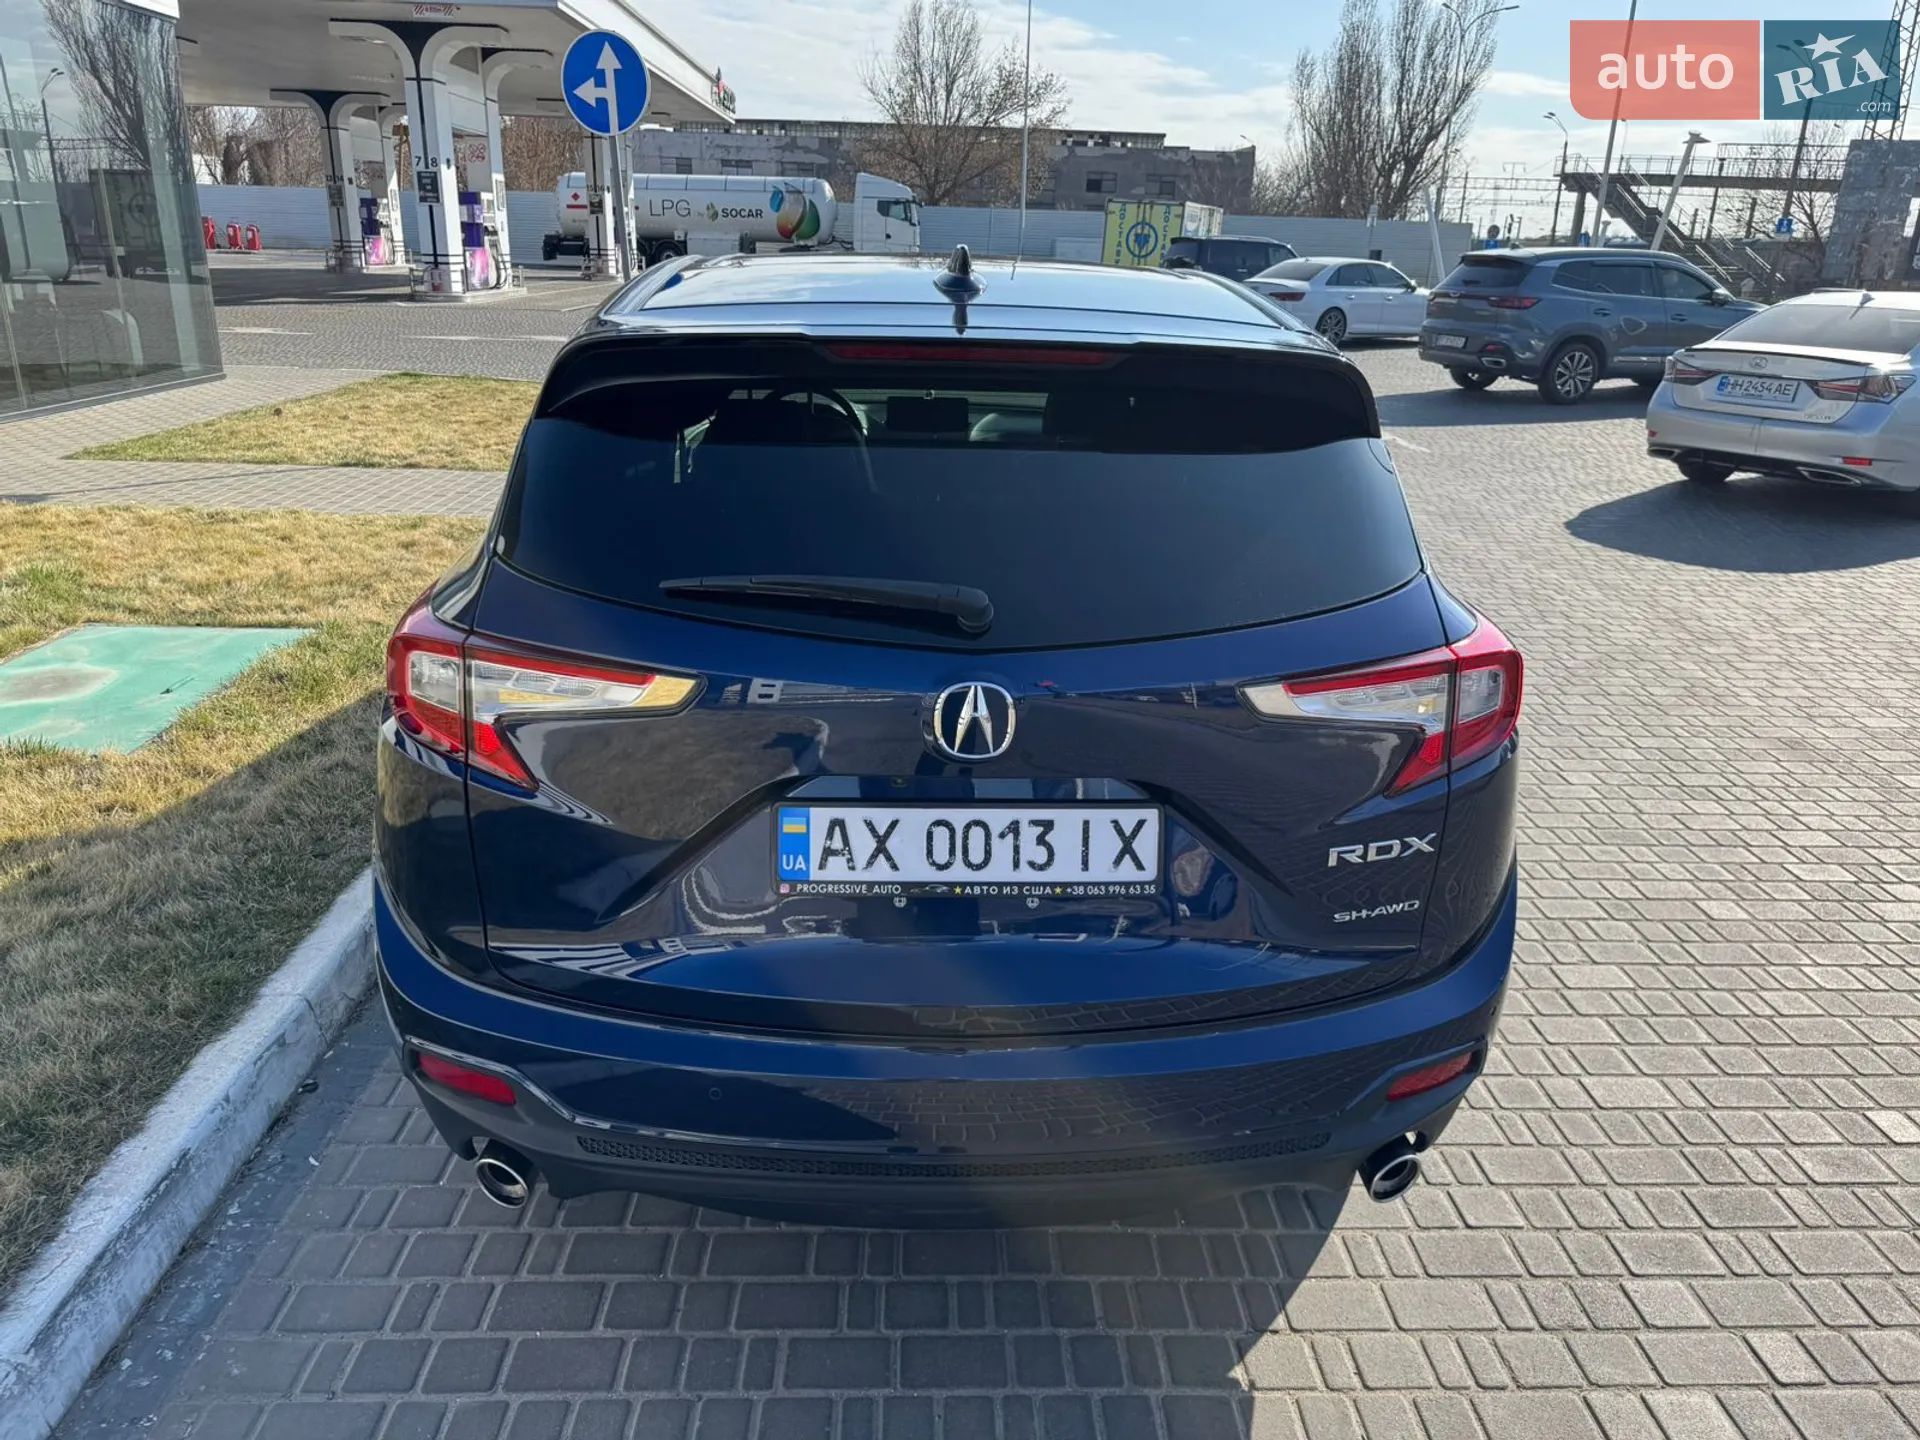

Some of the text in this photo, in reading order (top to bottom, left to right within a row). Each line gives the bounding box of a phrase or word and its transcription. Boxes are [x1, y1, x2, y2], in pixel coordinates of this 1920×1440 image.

[414, 155, 438, 168] 7 8
[649, 199, 691, 217] LPG
[721, 207, 763, 219] SOCAR
[1744, 380, 1775, 394] 2454
[1774, 382, 1794, 396] AE
[817, 818, 1147, 872] AX 0013 IX
[1328, 832, 1437, 867] RDX
[782, 859, 807, 871] UA
[964, 885, 1052, 895] АВТО ИЗ США
[1066, 884, 1156, 895] +38 063 996 63 35
[1333, 900, 1420, 923] SH-AWD
